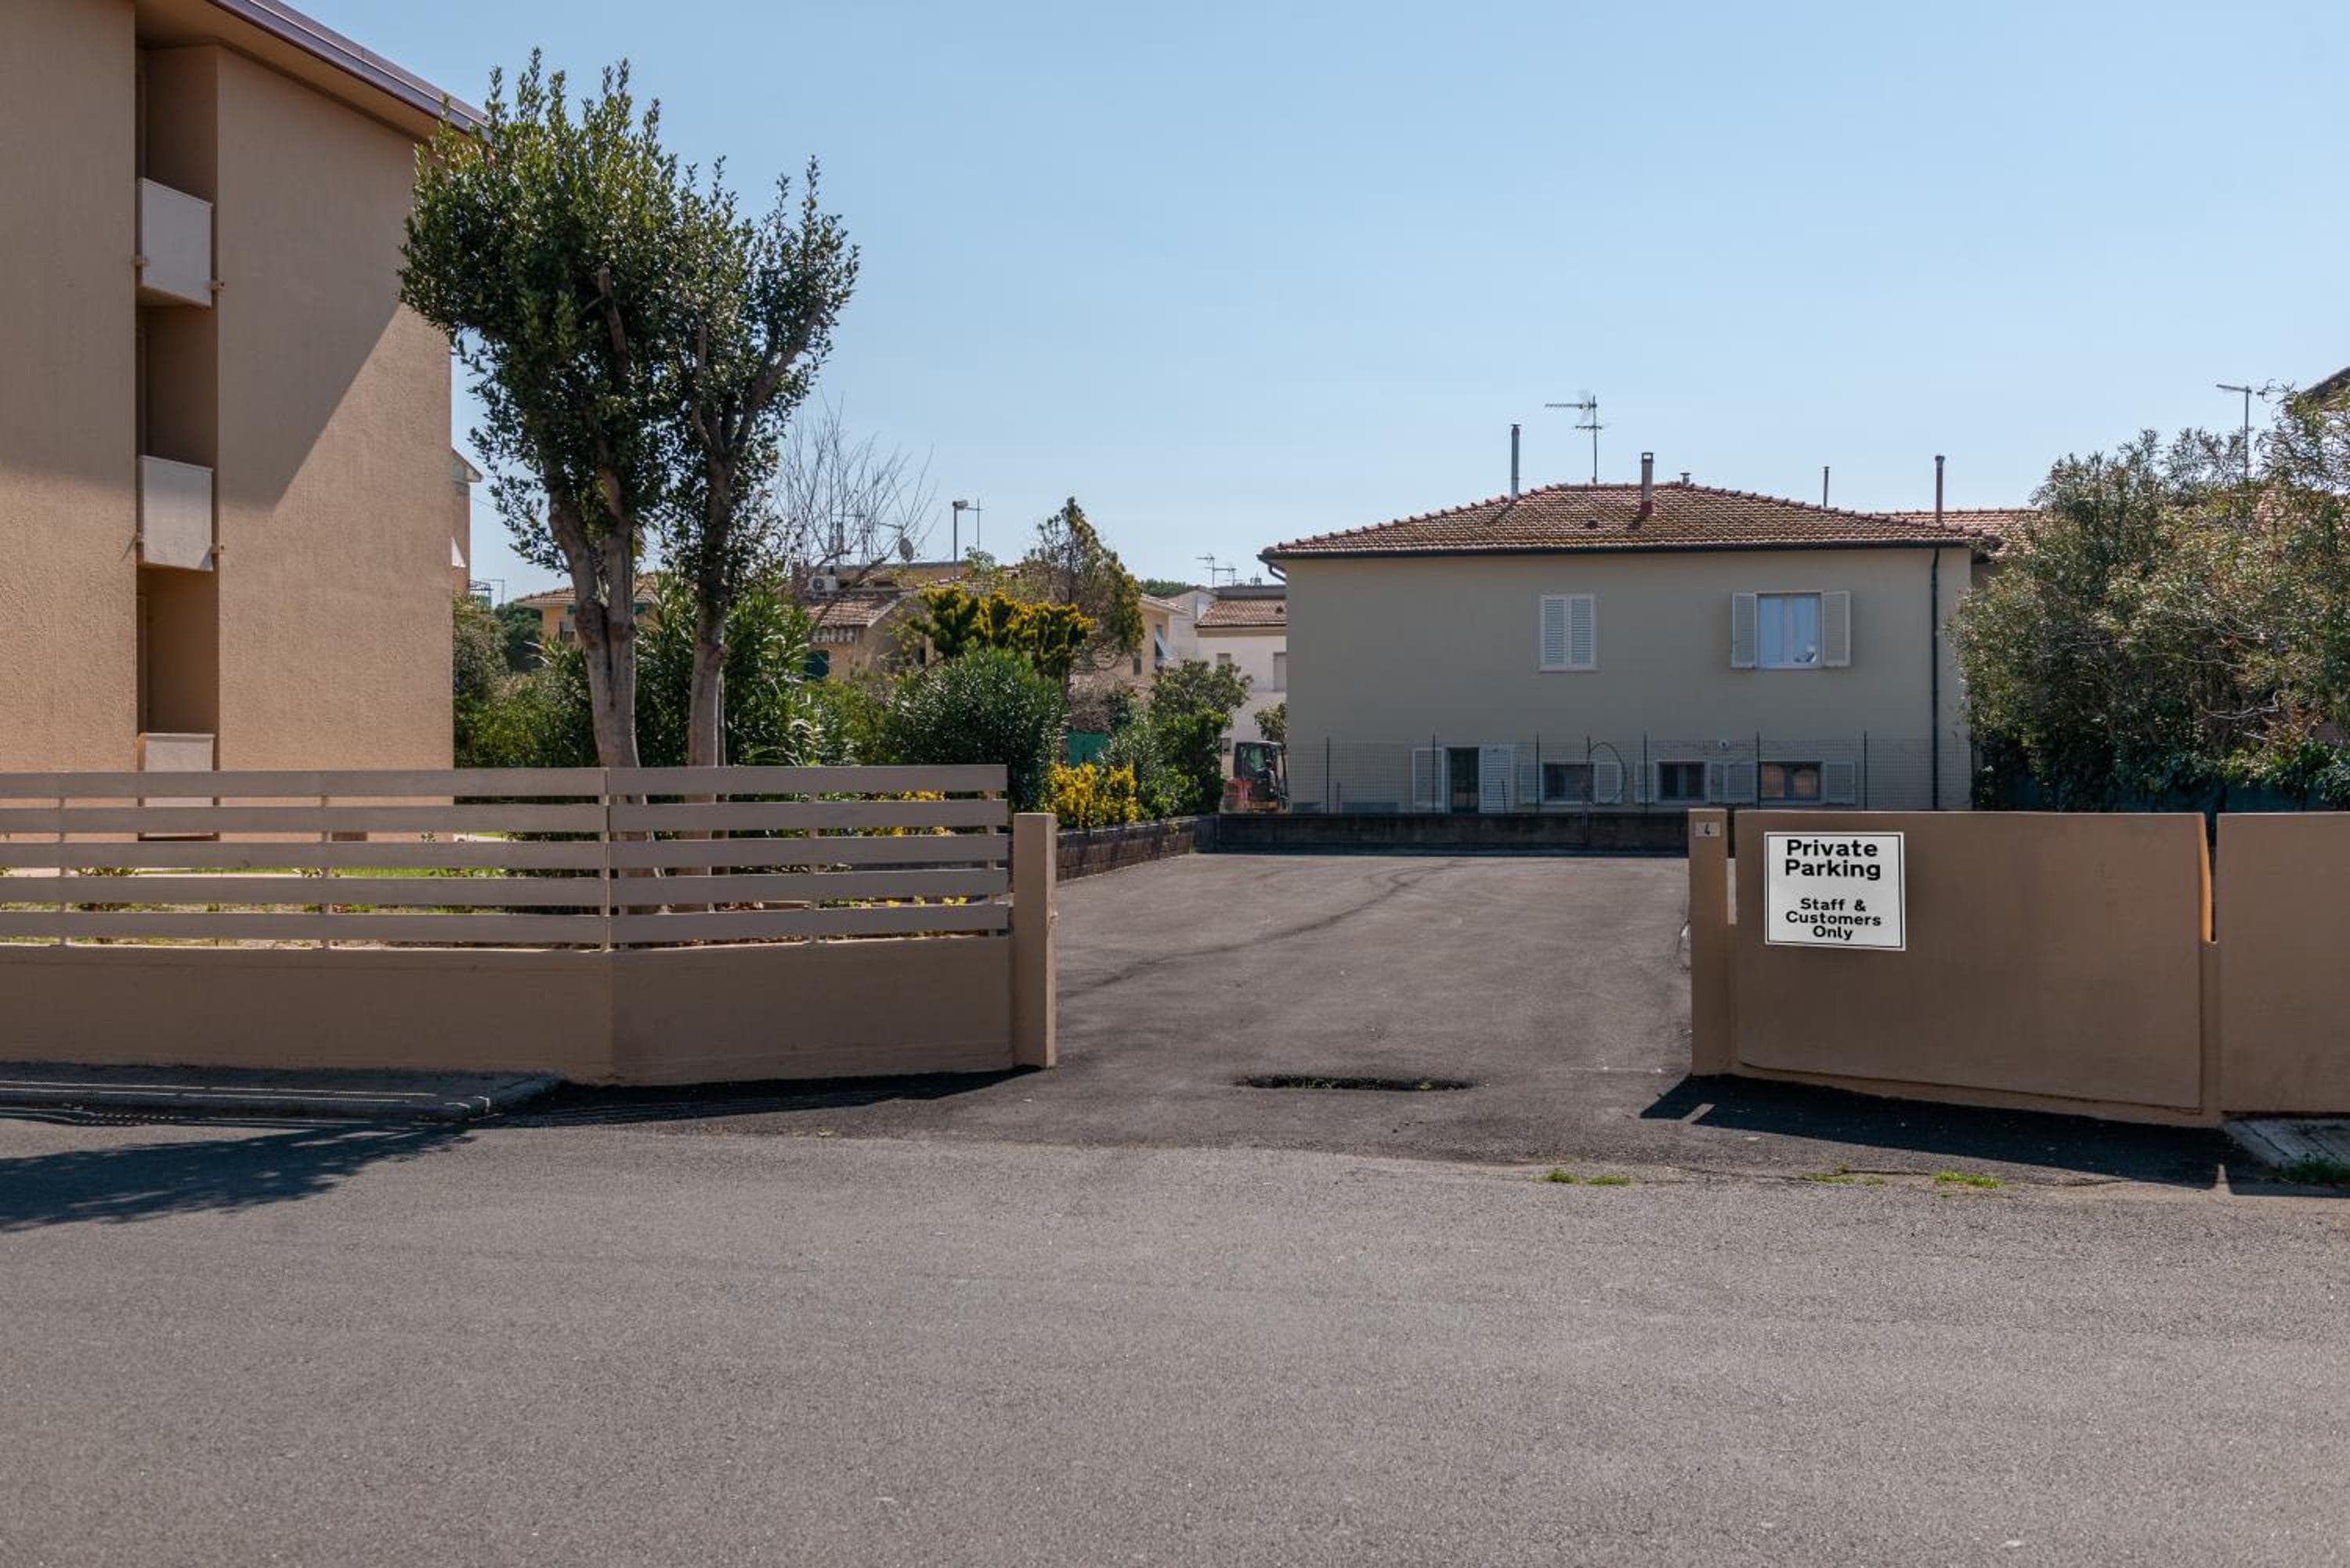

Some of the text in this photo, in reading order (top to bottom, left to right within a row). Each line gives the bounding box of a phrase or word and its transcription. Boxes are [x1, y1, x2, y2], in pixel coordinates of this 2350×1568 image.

[1787, 839, 1878, 857] Private
[1785, 858, 1881, 881] Parking
[1800, 898, 1867, 912] Staff &
[1785, 911, 1882, 927] Customers
[1813, 925, 1853, 941] Only
